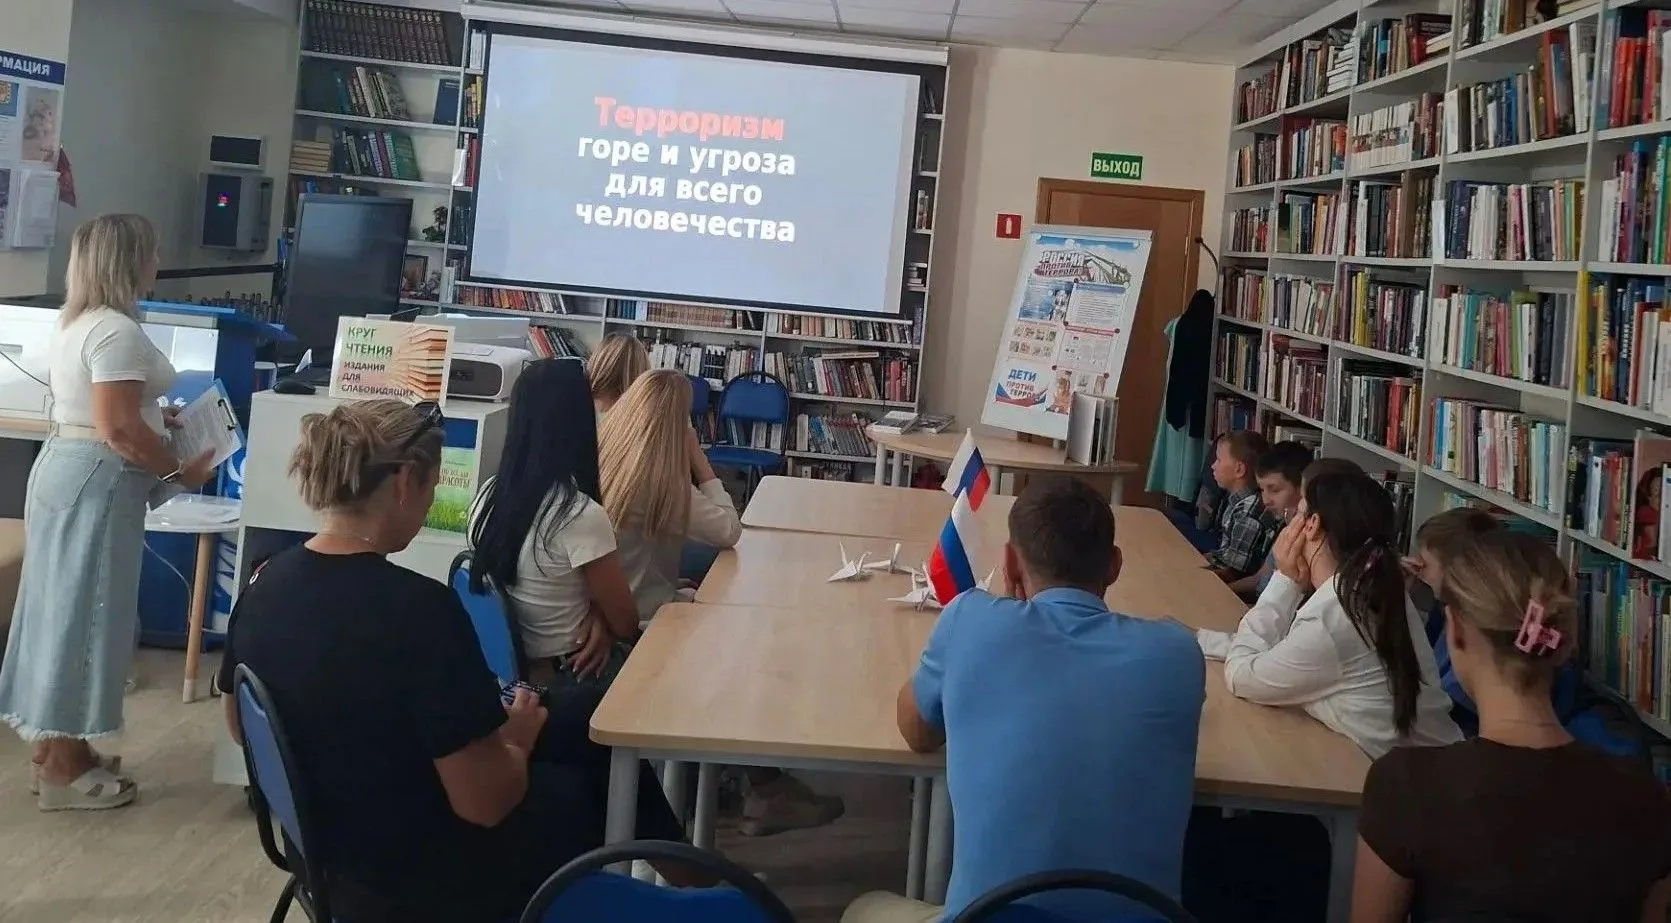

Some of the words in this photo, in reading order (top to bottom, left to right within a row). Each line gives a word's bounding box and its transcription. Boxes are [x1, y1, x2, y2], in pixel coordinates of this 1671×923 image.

[595, 96, 784, 142] Терроризм
[578, 137, 649, 167] горе
[660, 144, 679, 165] и
[689, 146, 796, 176] угроза
[1093, 159, 1140, 177] ВЫХОД
[604, 172, 666, 198] для
[676, 179, 763, 205] всего
[576, 203, 796, 242] человечества
[1039, 251, 1085, 267] РОССИЯ
[348, 327, 377, 339] КРУГ
[346, 343, 393, 356] ЧТЕНИЯ
[344, 361, 385, 372] ИЗДАНИЯ
[342, 372, 361, 381] ДЛЯ
[1008, 369, 1037, 382] ДЕТИ
[341, 384, 414, 397] СЛАБОВИДЯЩИХ
[1006, 381, 1035, 391] ПРОТИВ
